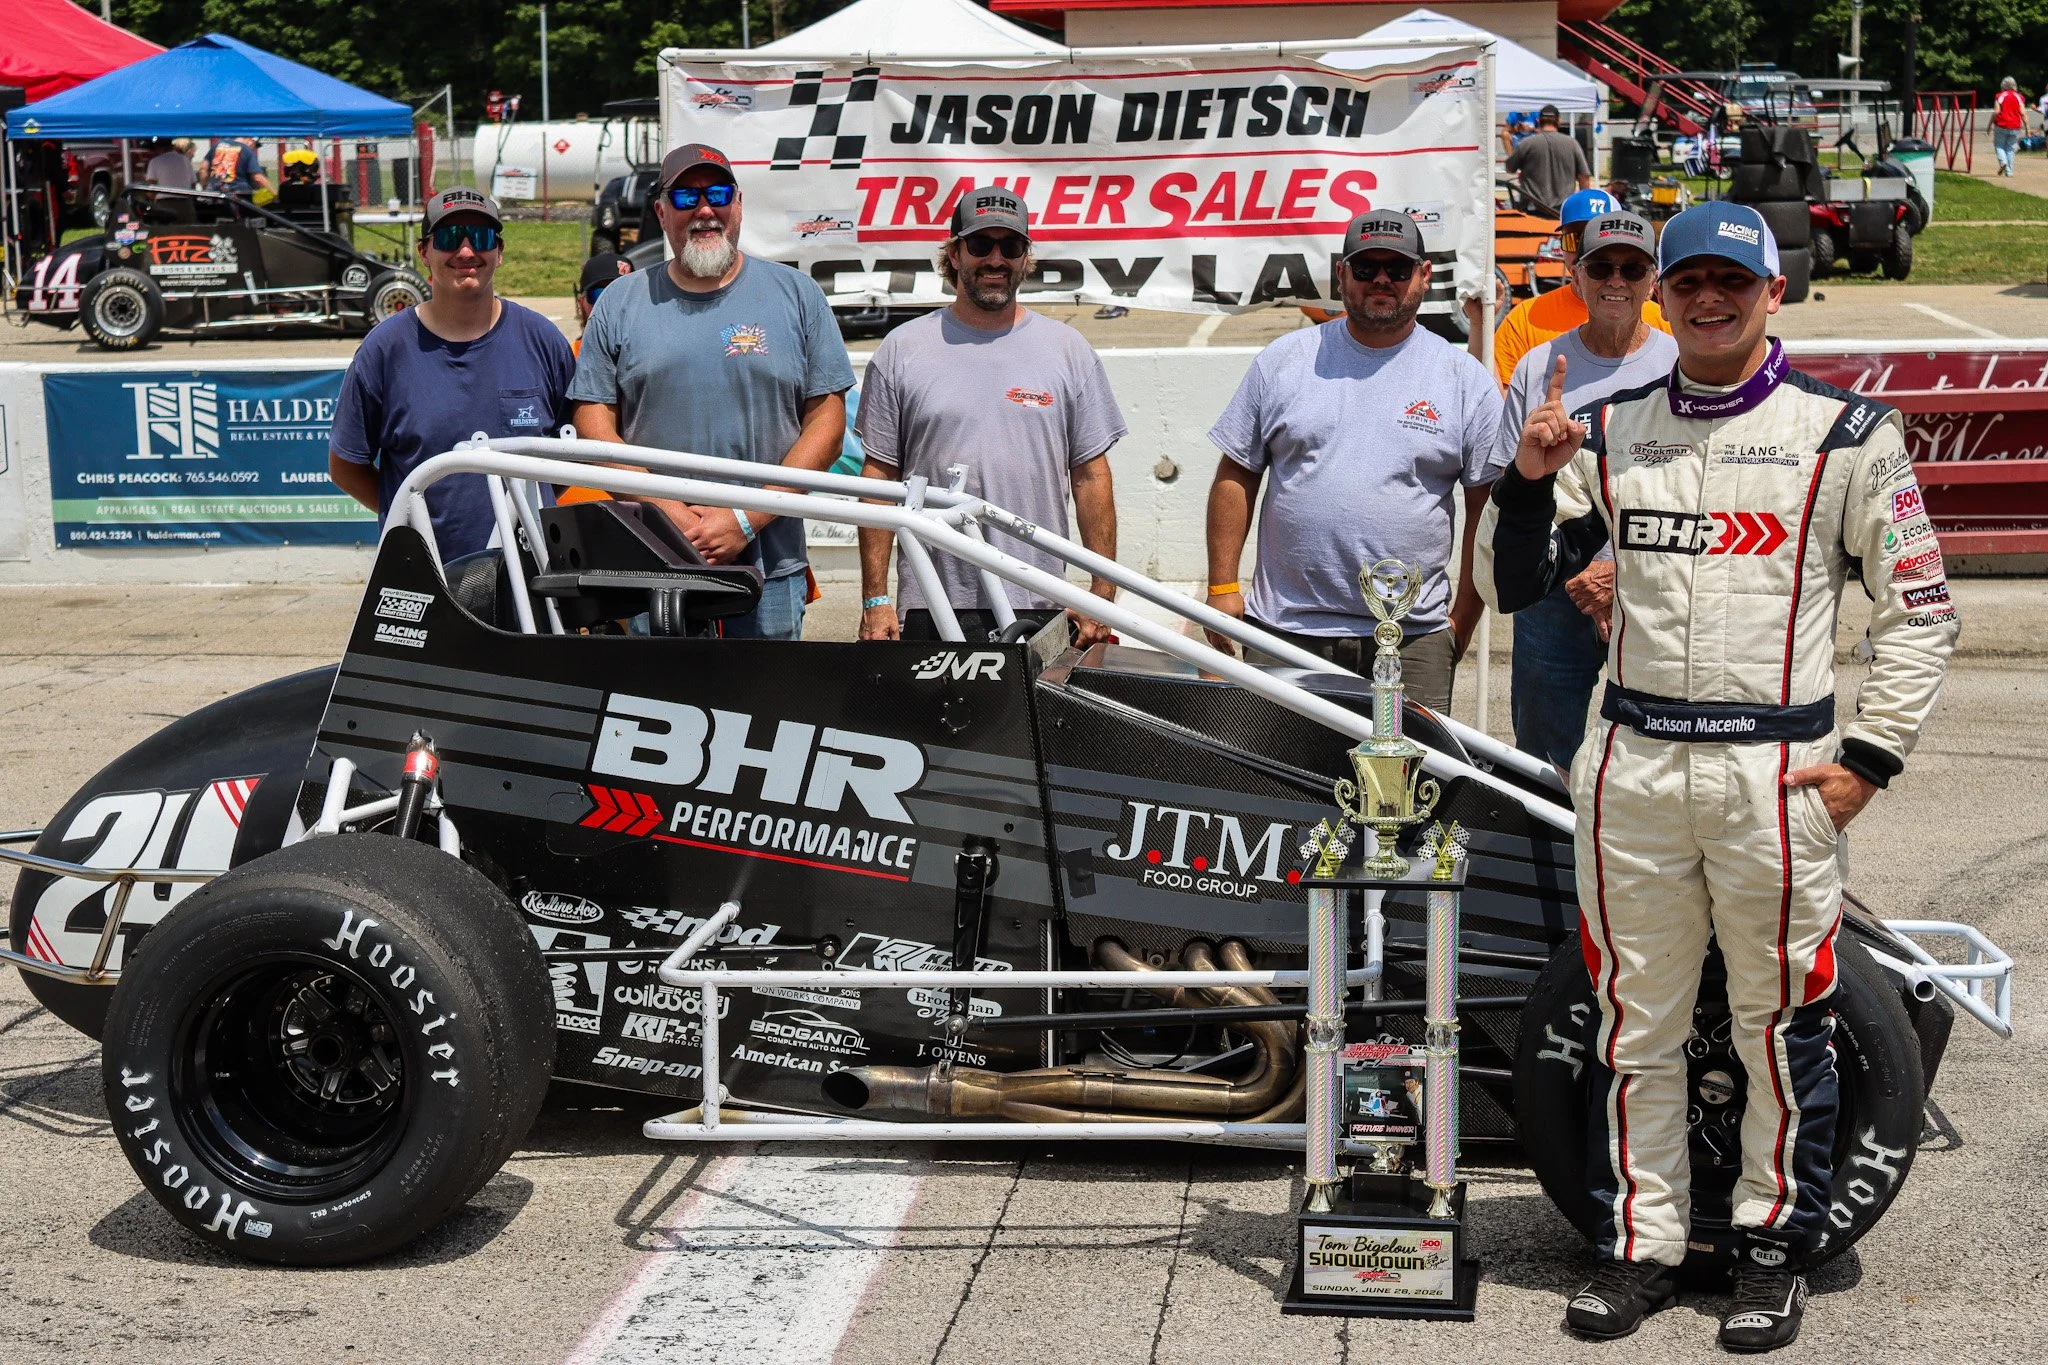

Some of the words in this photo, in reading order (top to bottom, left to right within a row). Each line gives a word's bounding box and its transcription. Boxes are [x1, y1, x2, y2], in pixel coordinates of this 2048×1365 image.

[890, 94, 1096, 145] JASON
[1116, 85, 1371, 143] DIETSCH
[443, 190, 485, 204] BHR
[976, 196, 1018, 211] BHR
[1149, 168, 1378, 228] SALES
[1590, 199, 1606, 214] 77
[1361, 220, 1404, 234] BHR
[1600, 219, 1644, 234] BHR
[1718, 222, 1760, 239] RACING
[28, 252, 83, 312] 14
[227, 398, 337, 423] HALDE
[1693, 396, 1745, 412] HOOSIER
[230, 432, 259, 442] REAL
[263, 432, 303, 442] ESTATE
[306, 432, 313, 441] &
[1633, 445, 1688, 455] Brockman
[1740, 445, 1777, 457] LANG
[1722, 456, 1739, 464] IRON
[1740, 456, 1764, 465] WORKS
[1764, 457, 1799, 466] COMPANY
[77, 472, 115, 484] CHRIS
[118, 472, 182, 484] PEACOCK:
[185, 472, 260, 484] 765.546.0592
[96, 504, 157, 516] APPRAISALS
[171, 503, 198, 515] REAL
[200, 503, 236, 515] ESTATE
[238, 503, 293, 514] AUCTIONS
[297, 503, 304, 514] &
[308, 502, 339, 514] SALES
[1895, 488, 1920, 513] 500
[147, 530, 221, 541] halderman.com
[1626, 514, 1729, 555] BHR
[397, 599, 423, 613] 500
[376, 623, 428, 640] RACING
[393, 638, 421, 646] AMERICA
[913, 651, 1006, 681] JMR
[1644, 714, 1691, 732] Jackson
[1694, 717, 1756, 733] Macenko
[591, 691, 925, 825] BHR
[669, 800, 917, 870] PERFORMANCE
[1107, 800, 1301, 885] J.T.M.
[1143, 869, 1192, 890] FOOD
[1196, 877, 1258, 898] GROUP
[527, 890, 574, 914] Redline
[572, 897, 598, 918] Ace
[321, 909, 460, 1089] Hoosier
[753, 985, 776, 995] IRON
[777, 987, 810, 1001] WORKS
[812, 995, 860, 1008] COMPANY
[840, 989, 861, 998] SONS
[750, 1019, 842, 1045] BROGAN
[842, 1035, 871, 1051] OIL
[767, 1035, 808, 1048] COMPLETE
[808, 1043, 829, 1052] AUTO
[829, 1046, 850, 1055] CARE
[592, 1046, 703, 1079] Snap-on
[731, 1044, 823, 1073] American
[917, 1043, 927, 1057] J.
[931, 1047, 987, 1066] OWENS
[1352, 1124, 1386, 1133] FEATURE
[1386, 1125, 1415, 1134] WINNER
[121, 1067, 260, 1241] Hoosier
[1318, 1234, 1349, 1251] Tom
[1353, 1236, 1418, 1257] Bigelow
[1421, 1239, 1441, 1248] 500
[1309, 1252, 1425, 1270] SHOWDOWN
[1756, 1251, 1781, 1262] BELL
[1312, 1284, 1359, 1293] SUNDAY,
[1361, 1286, 1392, 1294] JUNE
[1413, 1289, 1444, 1297] 2026
[1575, 1299, 1601, 1310] BELL
